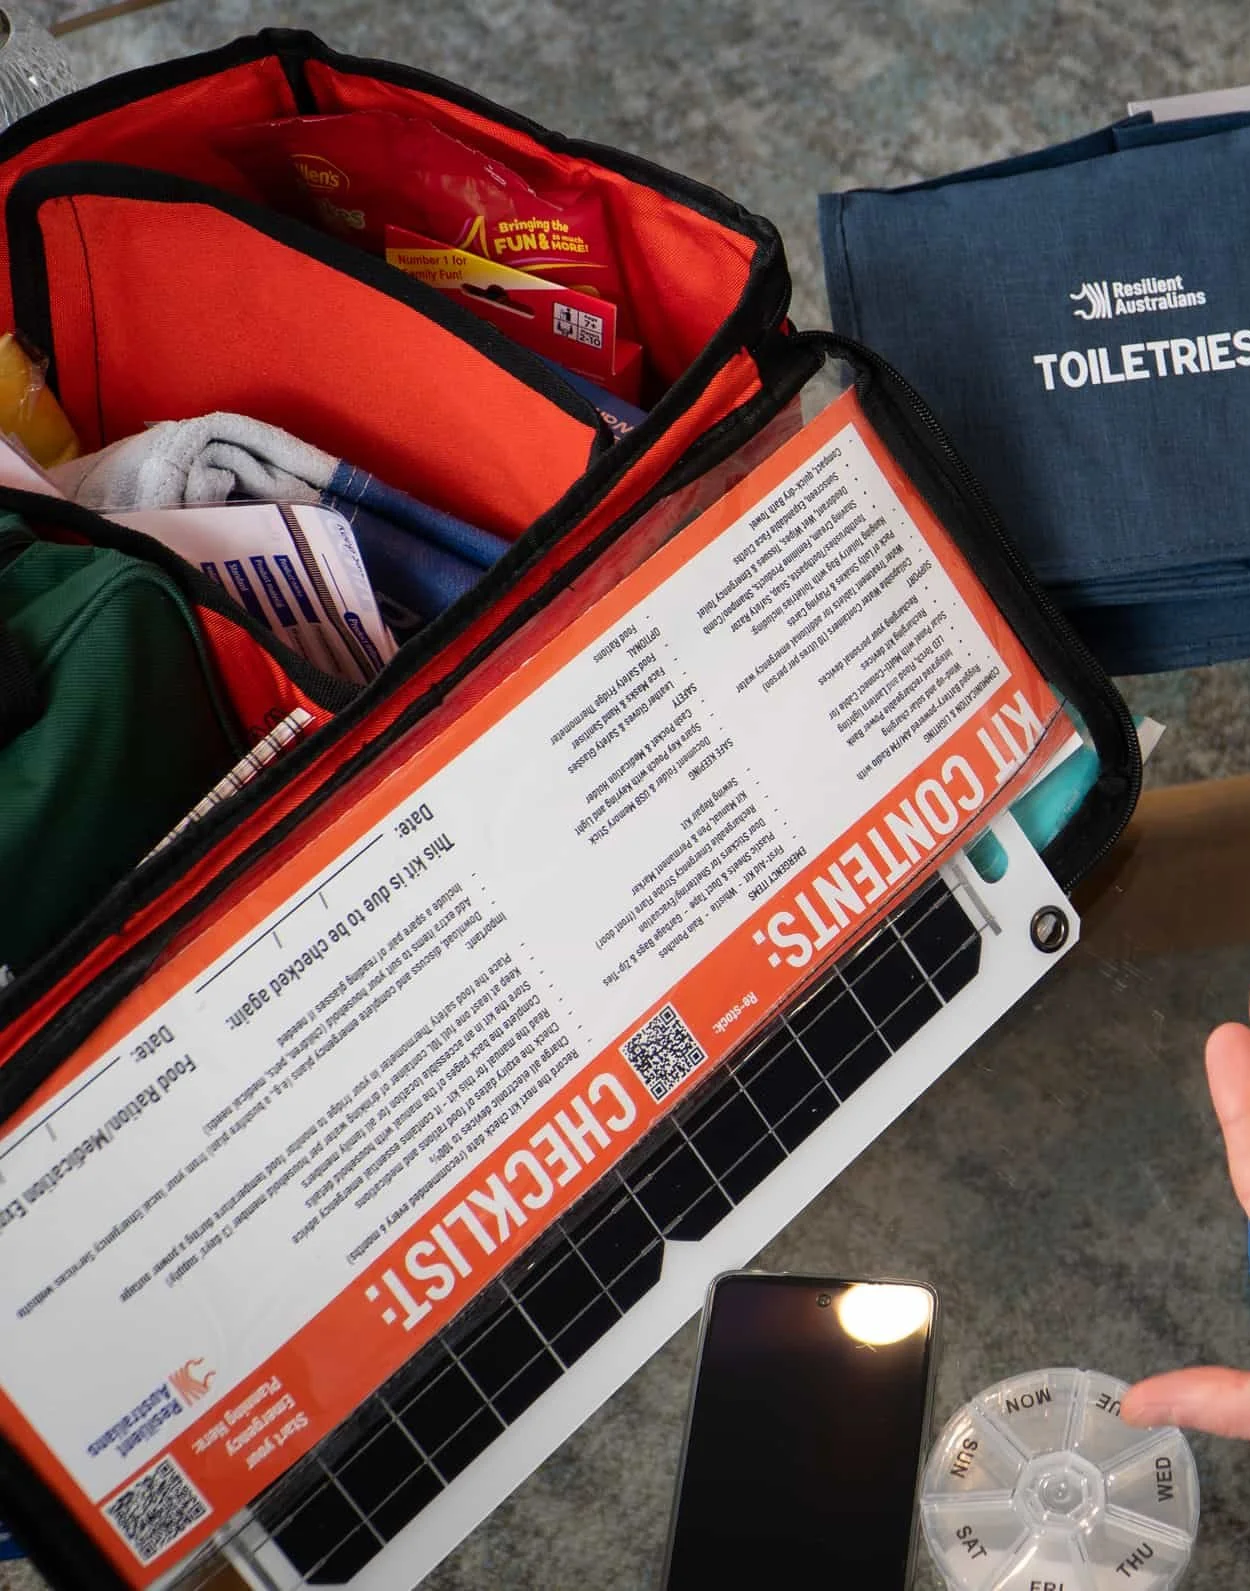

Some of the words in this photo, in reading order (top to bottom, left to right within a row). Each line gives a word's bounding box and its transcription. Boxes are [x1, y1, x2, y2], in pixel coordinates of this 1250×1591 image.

[294, 160, 340, 188] llen's
[499, 216, 550, 234] Bringing
[551, 217, 569, 233] the
[494, 232, 537, 254] FUN
[537, 231, 551, 250] &
[551, 240, 590, 253] MORE!
[397, 253, 442, 266] Number
[450, 254, 467, 266] for
[439, 268, 463, 281] Fun!
[1112, 274, 1184, 299] Resilient
[1115, 289, 1207, 316] Australians
[584, 319, 597, 329] 7+
[579, 334, 601, 347] 2-10
[811, 447, 841, 474] Compact,
[782, 470, 814, 501] quick-dry
[767, 496, 785, 513] Bath
[830, 499, 857, 523] Shaving
[748, 509, 771, 531] Towel
[808, 519, 834, 541] Cream,
[781, 538, 812, 566] Feminine
[751, 562, 784, 590] Products,
[905, 559, 932, 588] SUPPORT
[702, 588, 754, 634] Shampoo/Comb
[883, 593, 918, 627] Recharging
[617, 623, 638, 643] Food
[625, 626, 660, 658] OPTIONAL
[870, 622, 886, 640] your
[592, 637, 621, 663] Rations
[841, 634, 872, 665] personal
[647, 666, 666, 683] Face
[817, 660, 844, 685] devices
[921, 647, 953, 680] Integrated
[624, 679, 649, 702] Masks
[647, 680, 675, 706] Leather
[671, 682, 697, 709] SAFETY
[882, 674, 923, 714] rechargeable
[954, 665, 1000, 714] COMMUNICATION
[600, 704, 621, 725] Hand
[623, 702, 648, 725] Gloves
[863, 710, 885, 732] Power
[571, 719, 604, 749] Sanitiser
[594, 727, 620, 751] Safety
[845, 728, 865, 746] Bank
[922, 713, 952, 743] LIGHTING
[976, 690, 1047, 785] KIT
[567, 747, 597, 774] Glasses
[675, 735, 711, 768] Document
[713, 737, 733, 757] SAFE
[655, 764, 678, 787] Folder
[687, 751, 717, 780] KEEPING
[634, 788, 651, 806] USB
[711, 776, 738, 801] Sewing
[735, 789, 747, 804] Kit
[393, 802, 434, 838] Date:
[606, 801, 636, 828] Memory
[691, 797, 715, 821] Repair
[708, 799, 737, 824] Manual,
[587, 825, 609, 844] Stick
[679, 816, 693, 830] Kit
[695, 821, 712, 836] Pen
[709, 803, 756, 846] Rechargeable
[423, 832, 455, 860] This
[653, 839, 693, 875] Permanent
[402, 855, 427, 879] kit
[674, 842, 712, 878] Emergency
[752, 754, 988, 967] CONTENTS:
[767, 845, 807, 884] EMERGENCY
[388, 872, 405, 889] is
[631, 870, 657, 896] Marker
[651, 874, 677, 898] Strobe
[747, 879, 769, 901] ITEMS
[362, 885, 390, 912] due
[431, 882, 463, 910] Include
[633, 894, 654, 913] Flare
[346, 908, 366, 926] to
[402, 912, 427, 936] spare
[464, 911, 507, 950] Important:
[613, 910, 636, 932] (front
[327, 921, 351, 942] be
[387, 930, 404, 951] pair
[594, 928, 615, 950] door)
[268, 938, 328, 996] checked
[344, 955, 378, 985] reading
[225, 988, 270, 1029] again:
[314, 980, 347, 1013] glasses
[712, 991, 758, 1033] Re-stock:
[129, 1024, 174, 1062] Date:
[276, 1016, 308, 1047] needed
[539, 1034, 569, 1062] Charge
[156, 1053, 196, 1093] Food
[528, 1059, 541, 1074] all
[490, 1069, 530, 1108] electronic
[460, 1104, 492, 1135] devices
[22, 1084, 161, 1203] Ration/Medication
[365, 1072, 636, 1330] CHECKLIST:
[223, 1375, 282, 1425] Planning
[1005, 1388, 1053, 1415] MON
[1096, 1392, 1122, 1417] UE
[87, 1383, 170, 1456] Australians
[115, 1396, 183, 1458] Resilient
[225, 1393, 295, 1456] Emergency
[273, 1411, 308, 1445] Start
[246, 1436, 275, 1468] your
[950, 1437, 979, 1479] SUN
[1155, 1456, 1175, 1503] WED
[956, 1525, 988, 1561] SAT
[1115, 1542, 1155, 1580] THU
[1030, 1580, 1065, 1591] FRI
